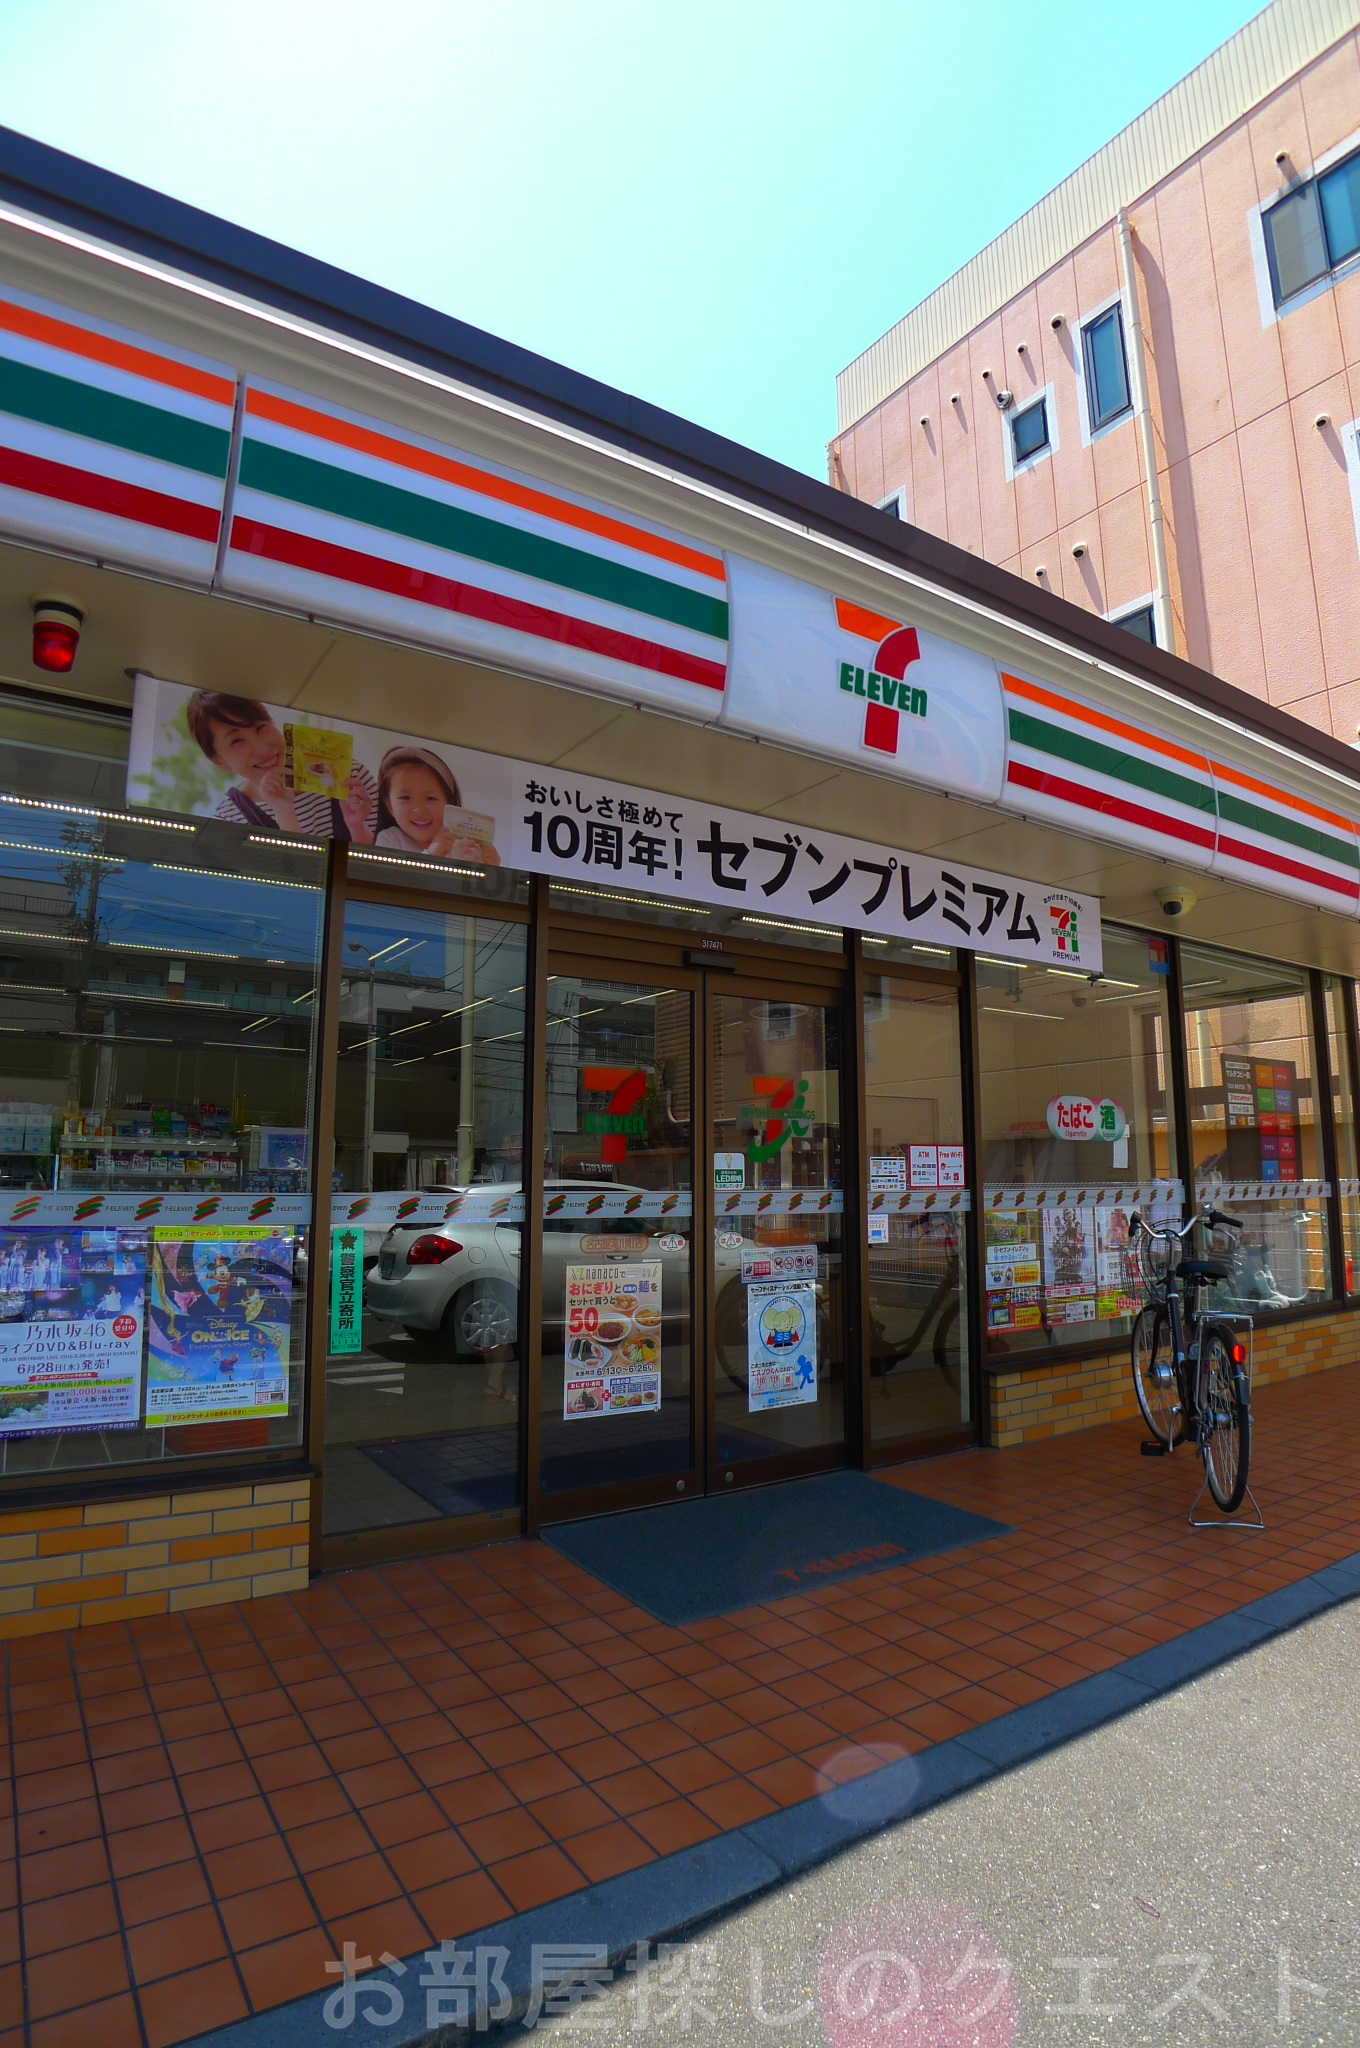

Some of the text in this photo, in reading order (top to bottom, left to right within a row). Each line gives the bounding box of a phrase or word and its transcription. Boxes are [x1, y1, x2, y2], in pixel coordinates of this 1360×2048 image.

[525, 779, 684, 834] おいしさ極めて
[523, 811, 685, 881] 10周年!
[697, 820, 1042, 946] セブンプレミアム
[701, 940, 724, 950] 317471
[1052, 950, 1081, 962] PREMIUM
[1057, 1102, 1094, 1128] たばこ
[1100, 1105, 1116, 1129] 酒
[1065, 1129, 1088, 1138] cigarette
[338, 1252, 357, 1330] 警察官立寄所
[569, 1281, 621, 1296] おにぎりと
[638, 1280, 658, 1293] 麺を
[569, 1295, 616, 1306] セットで買うと
[206, 1318, 239, 1330] Disney
[569, 1307, 599, 1333] 50
[27, 1322, 106, 1340] 乃木坂46
[226, 1329, 250, 1341] ICE
[0, 1340, 130, 1354] ライブDVD&Blu-ray
